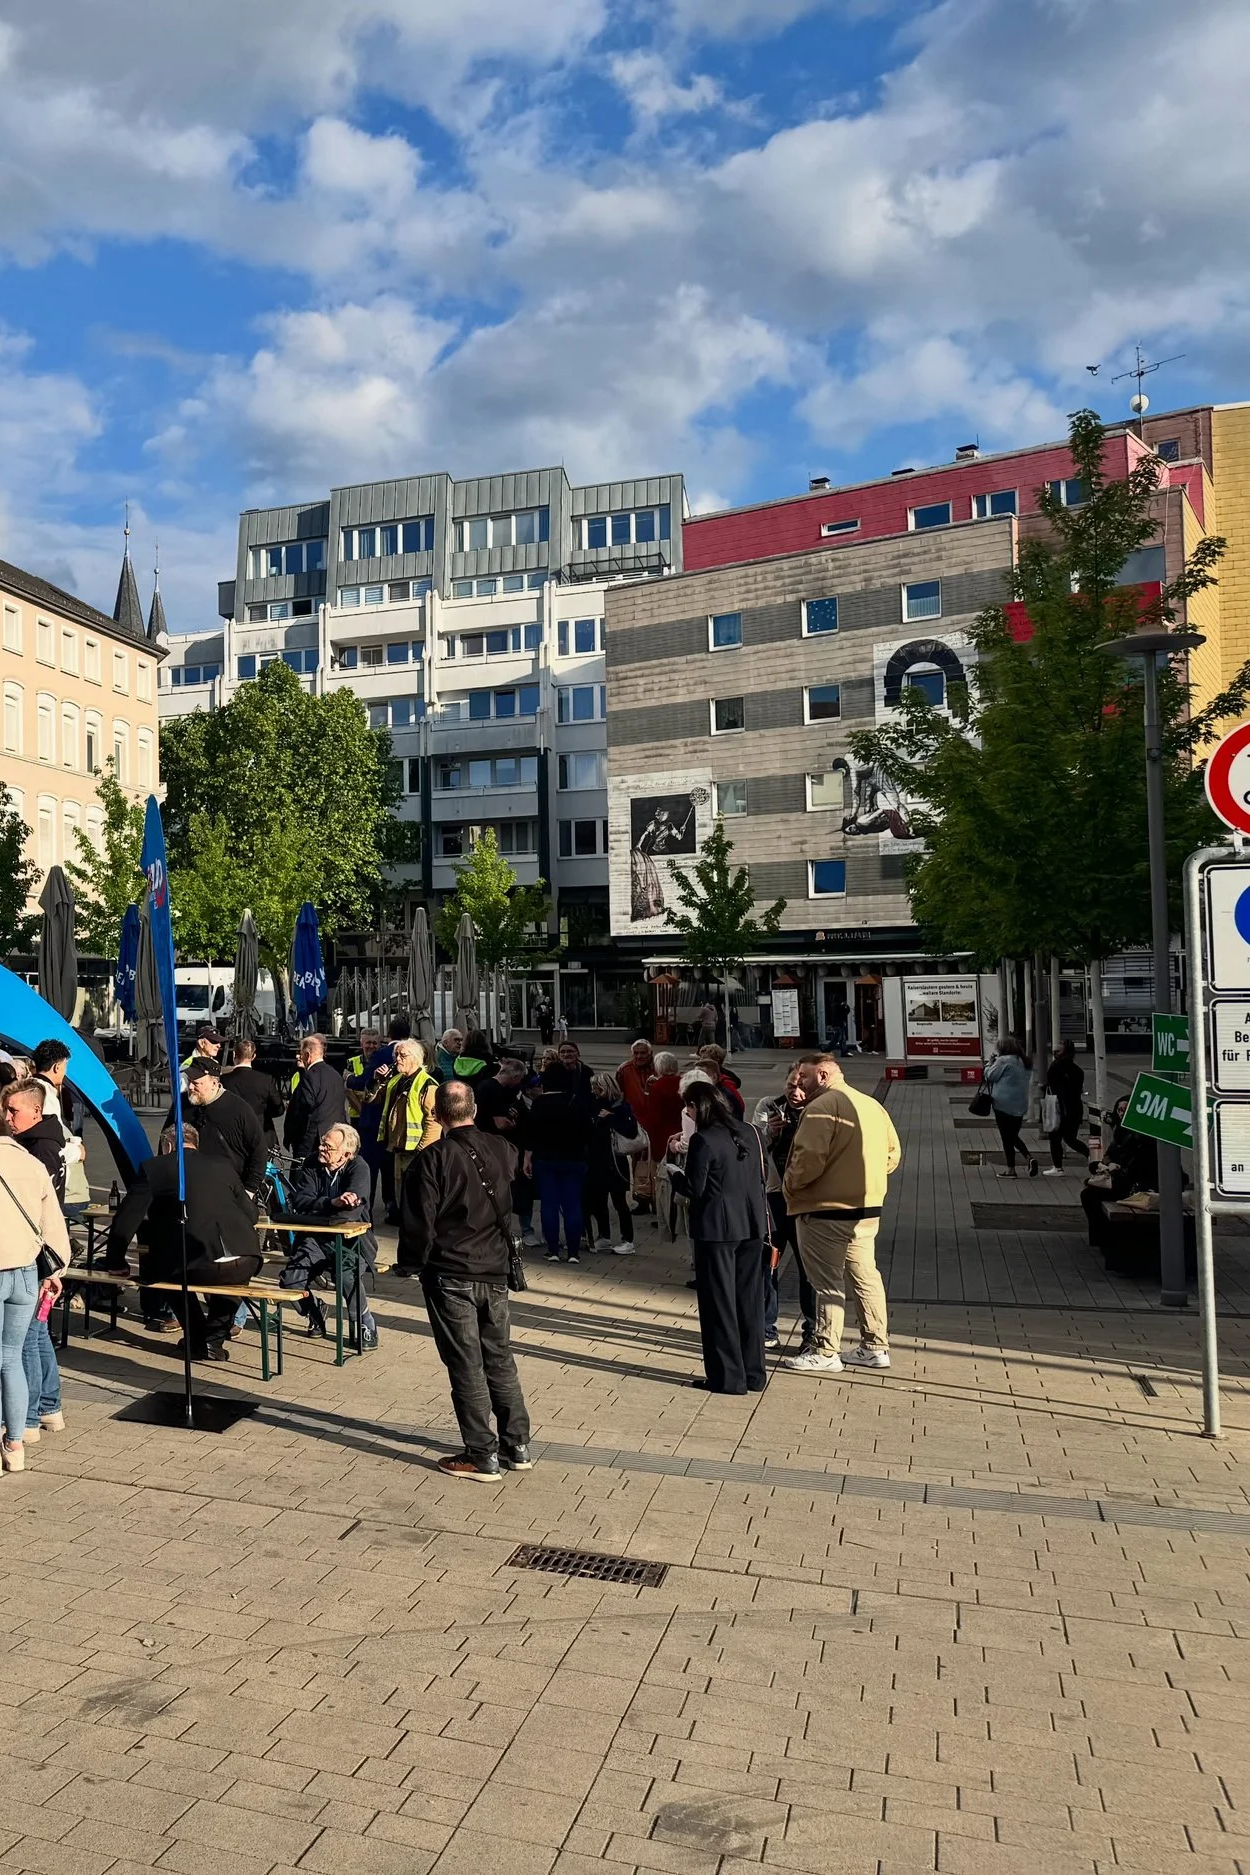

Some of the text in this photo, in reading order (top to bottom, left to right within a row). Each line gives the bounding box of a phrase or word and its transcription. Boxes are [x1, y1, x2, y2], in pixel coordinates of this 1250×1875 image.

[1157, 1032, 1175, 1057] WC
[1222, 1050, 1240, 1062] für
[1136, 1090, 1169, 1121] WC
[1231, 1163, 1244, 1173] an
